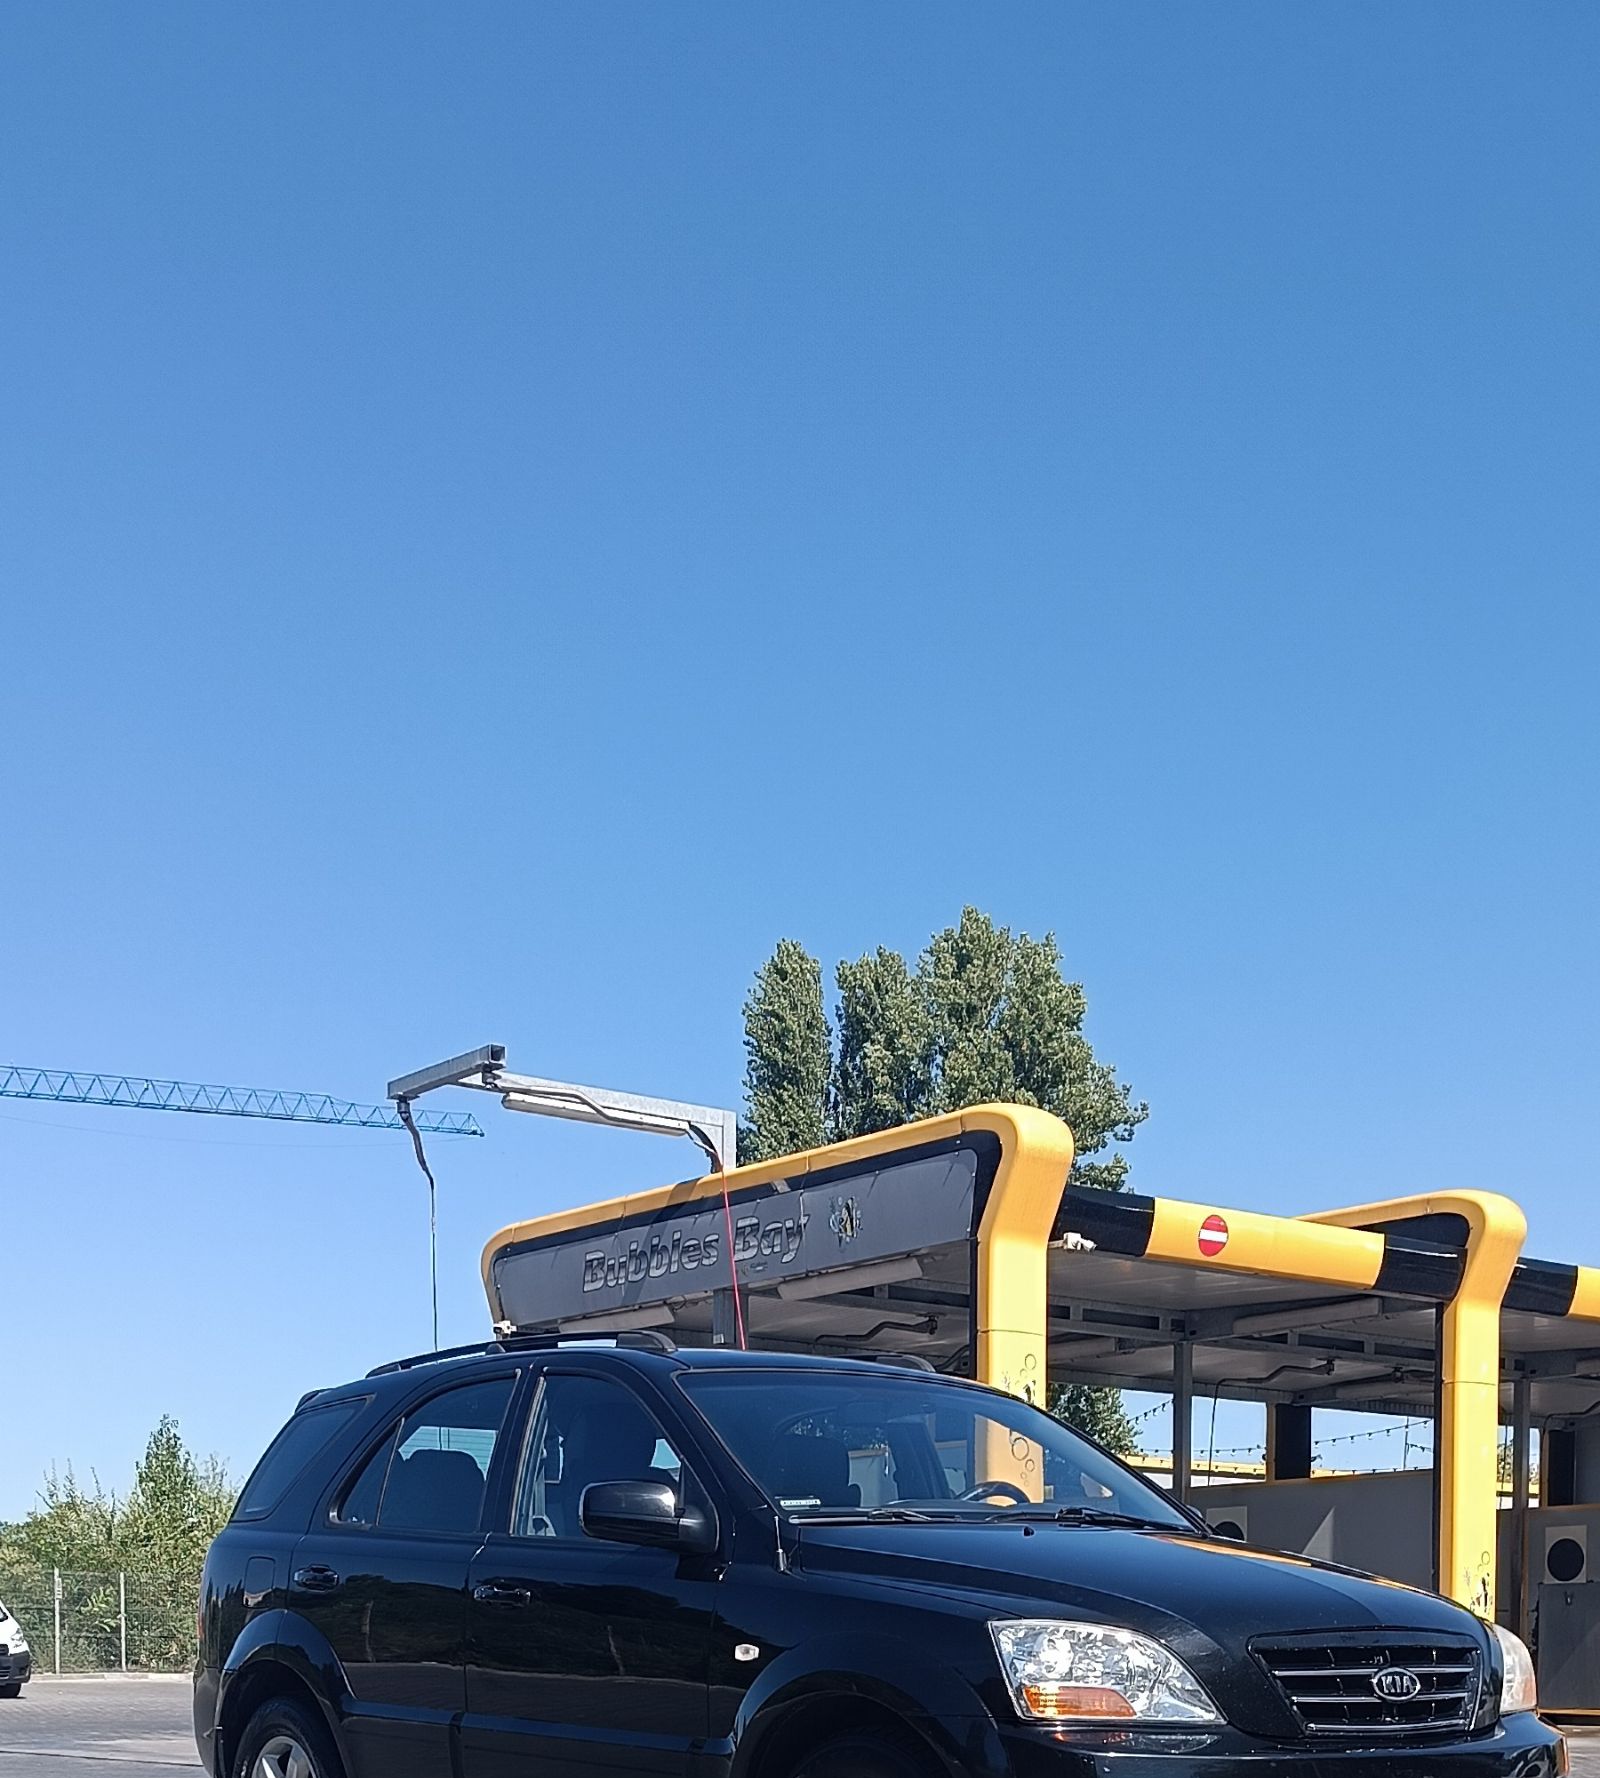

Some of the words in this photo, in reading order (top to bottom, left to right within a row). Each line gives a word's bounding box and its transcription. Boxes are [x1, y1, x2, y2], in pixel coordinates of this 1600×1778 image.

[583, 1230, 719, 1293] Bubbles
[733, 1214, 810, 1263] Bay
[1381, 1675, 1415, 1693] KIA
